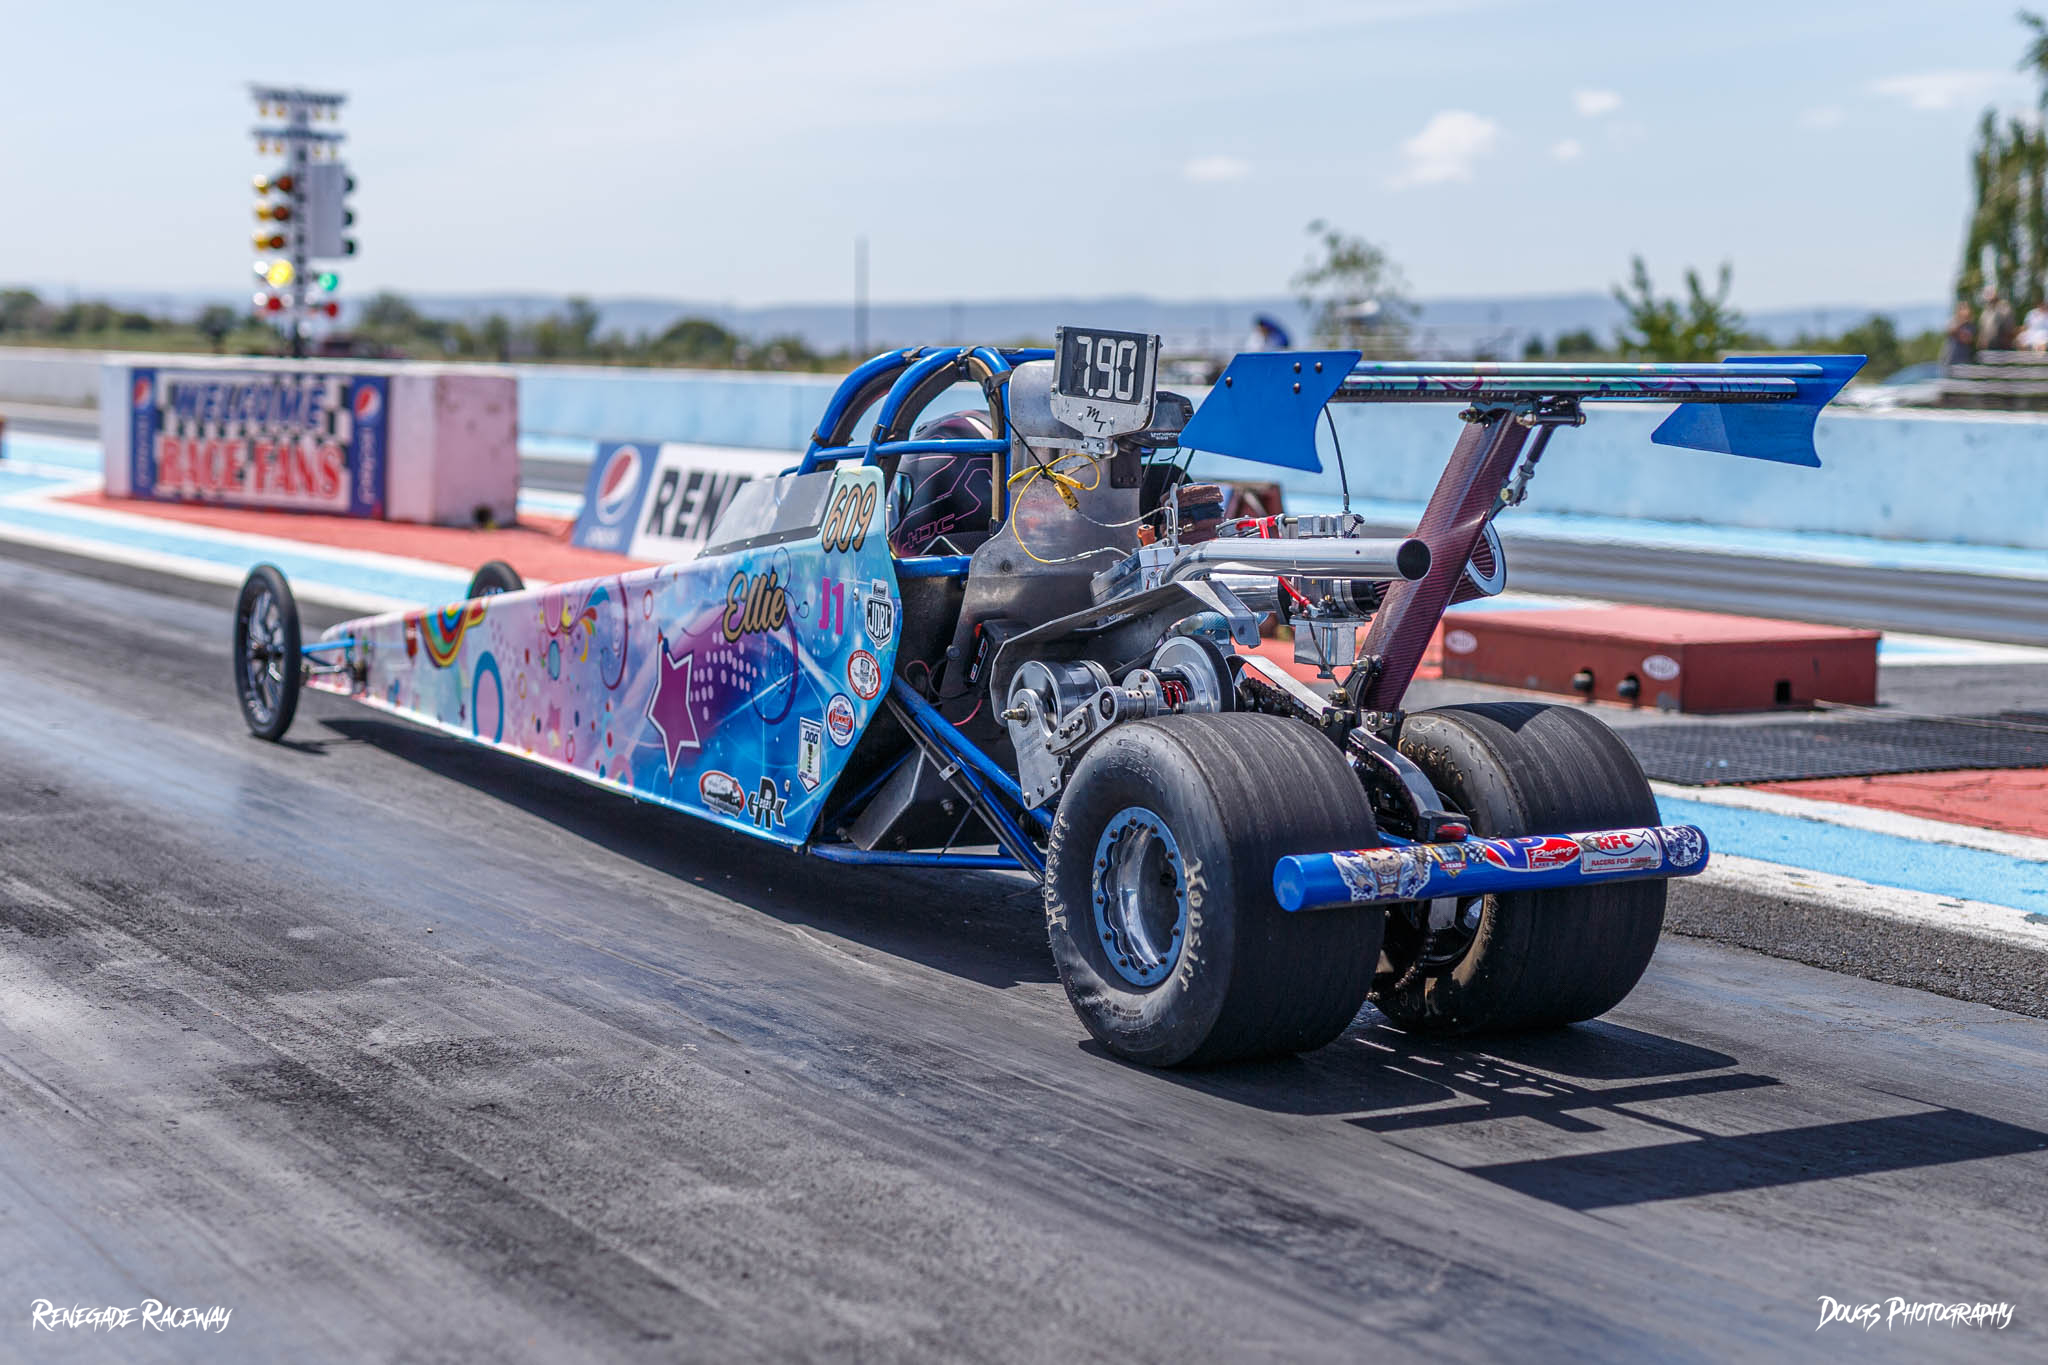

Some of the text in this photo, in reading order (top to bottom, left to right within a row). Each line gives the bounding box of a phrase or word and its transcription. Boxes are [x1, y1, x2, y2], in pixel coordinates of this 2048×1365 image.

[1075, 335, 1139, 401] 7.90
[168, 381, 327, 429] WELCOME
[157, 433, 247, 492] RACE
[253, 438, 346, 500] FANS
[822, 480, 878, 554] 609
[722, 569, 788, 643] Ellie
[818, 576, 845, 636] J1
[868, 601, 891, 639] JDRL
[1529, 846, 1580, 862] Racing
[1594, 834, 1635, 851] RFC
